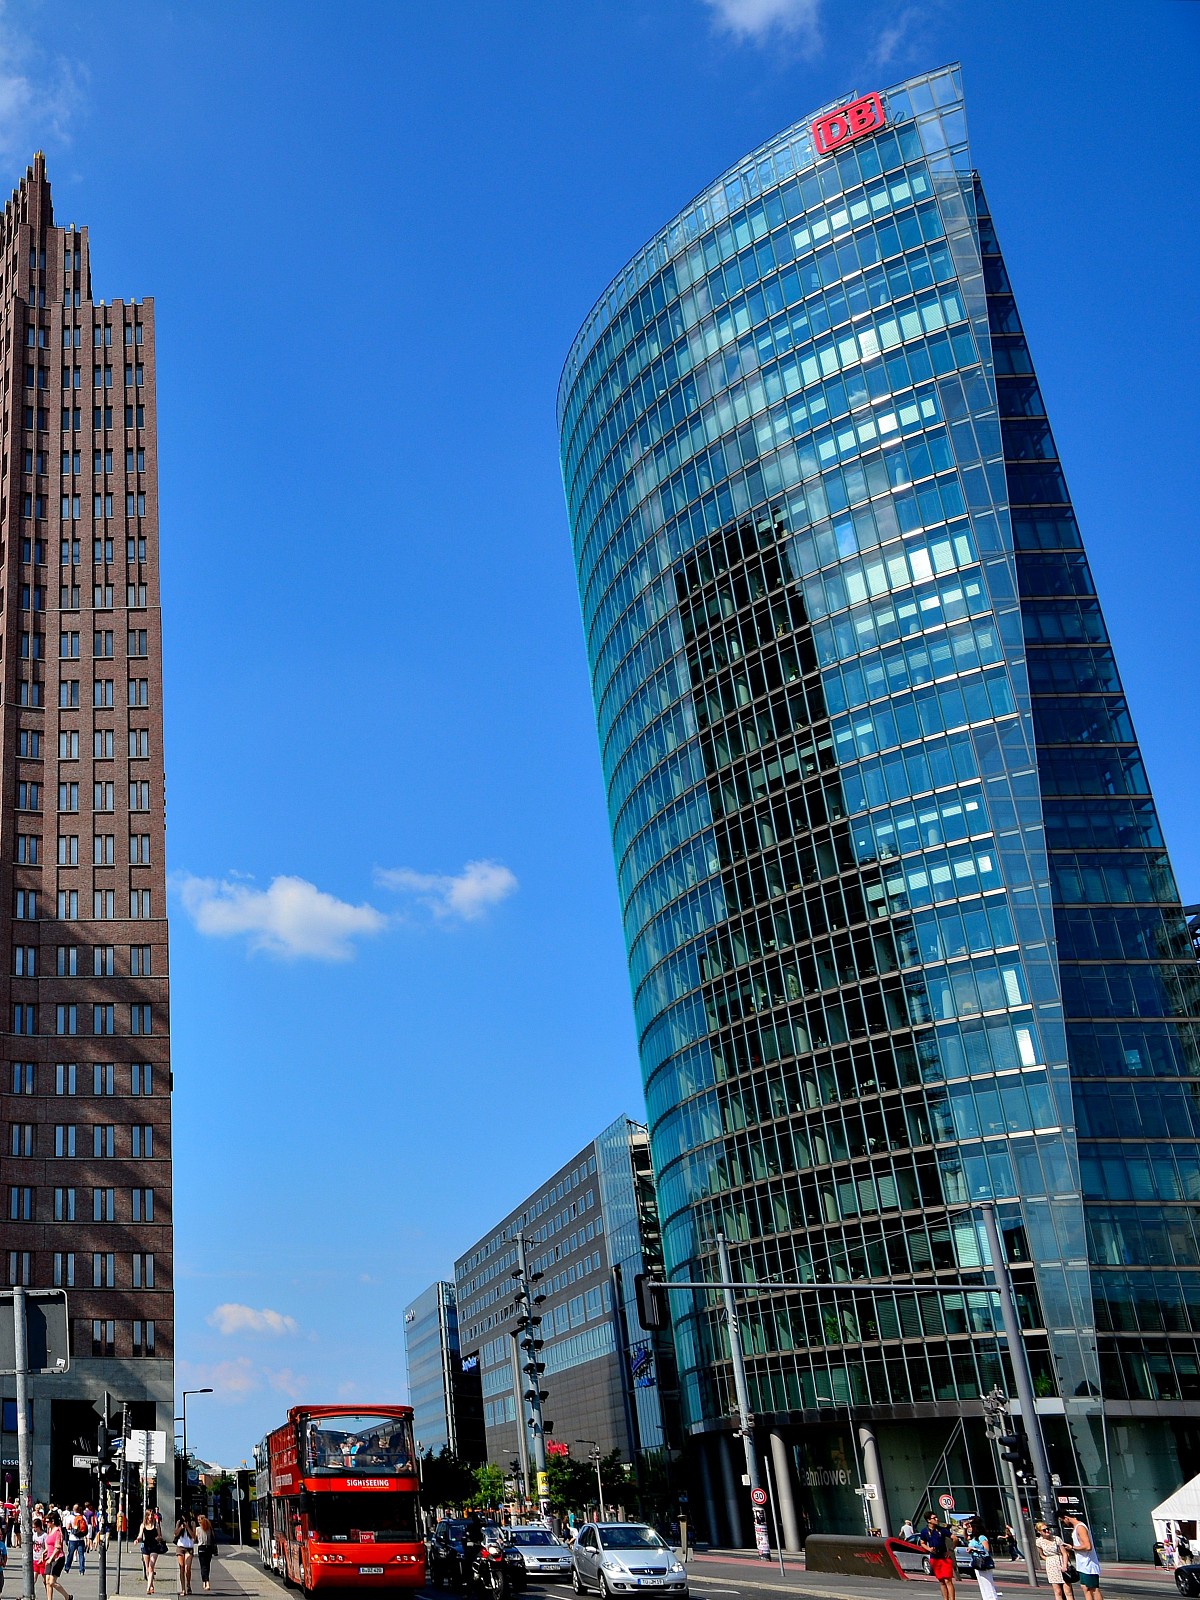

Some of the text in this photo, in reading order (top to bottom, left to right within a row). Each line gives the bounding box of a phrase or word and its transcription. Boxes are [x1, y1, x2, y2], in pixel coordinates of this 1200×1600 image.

[818, 99, 878, 149] DB
[346, 1479, 389, 1487] SIGHTSEEING
[754, 1492, 764, 1500] 30
[942, 1498, 952, 1506] 30
